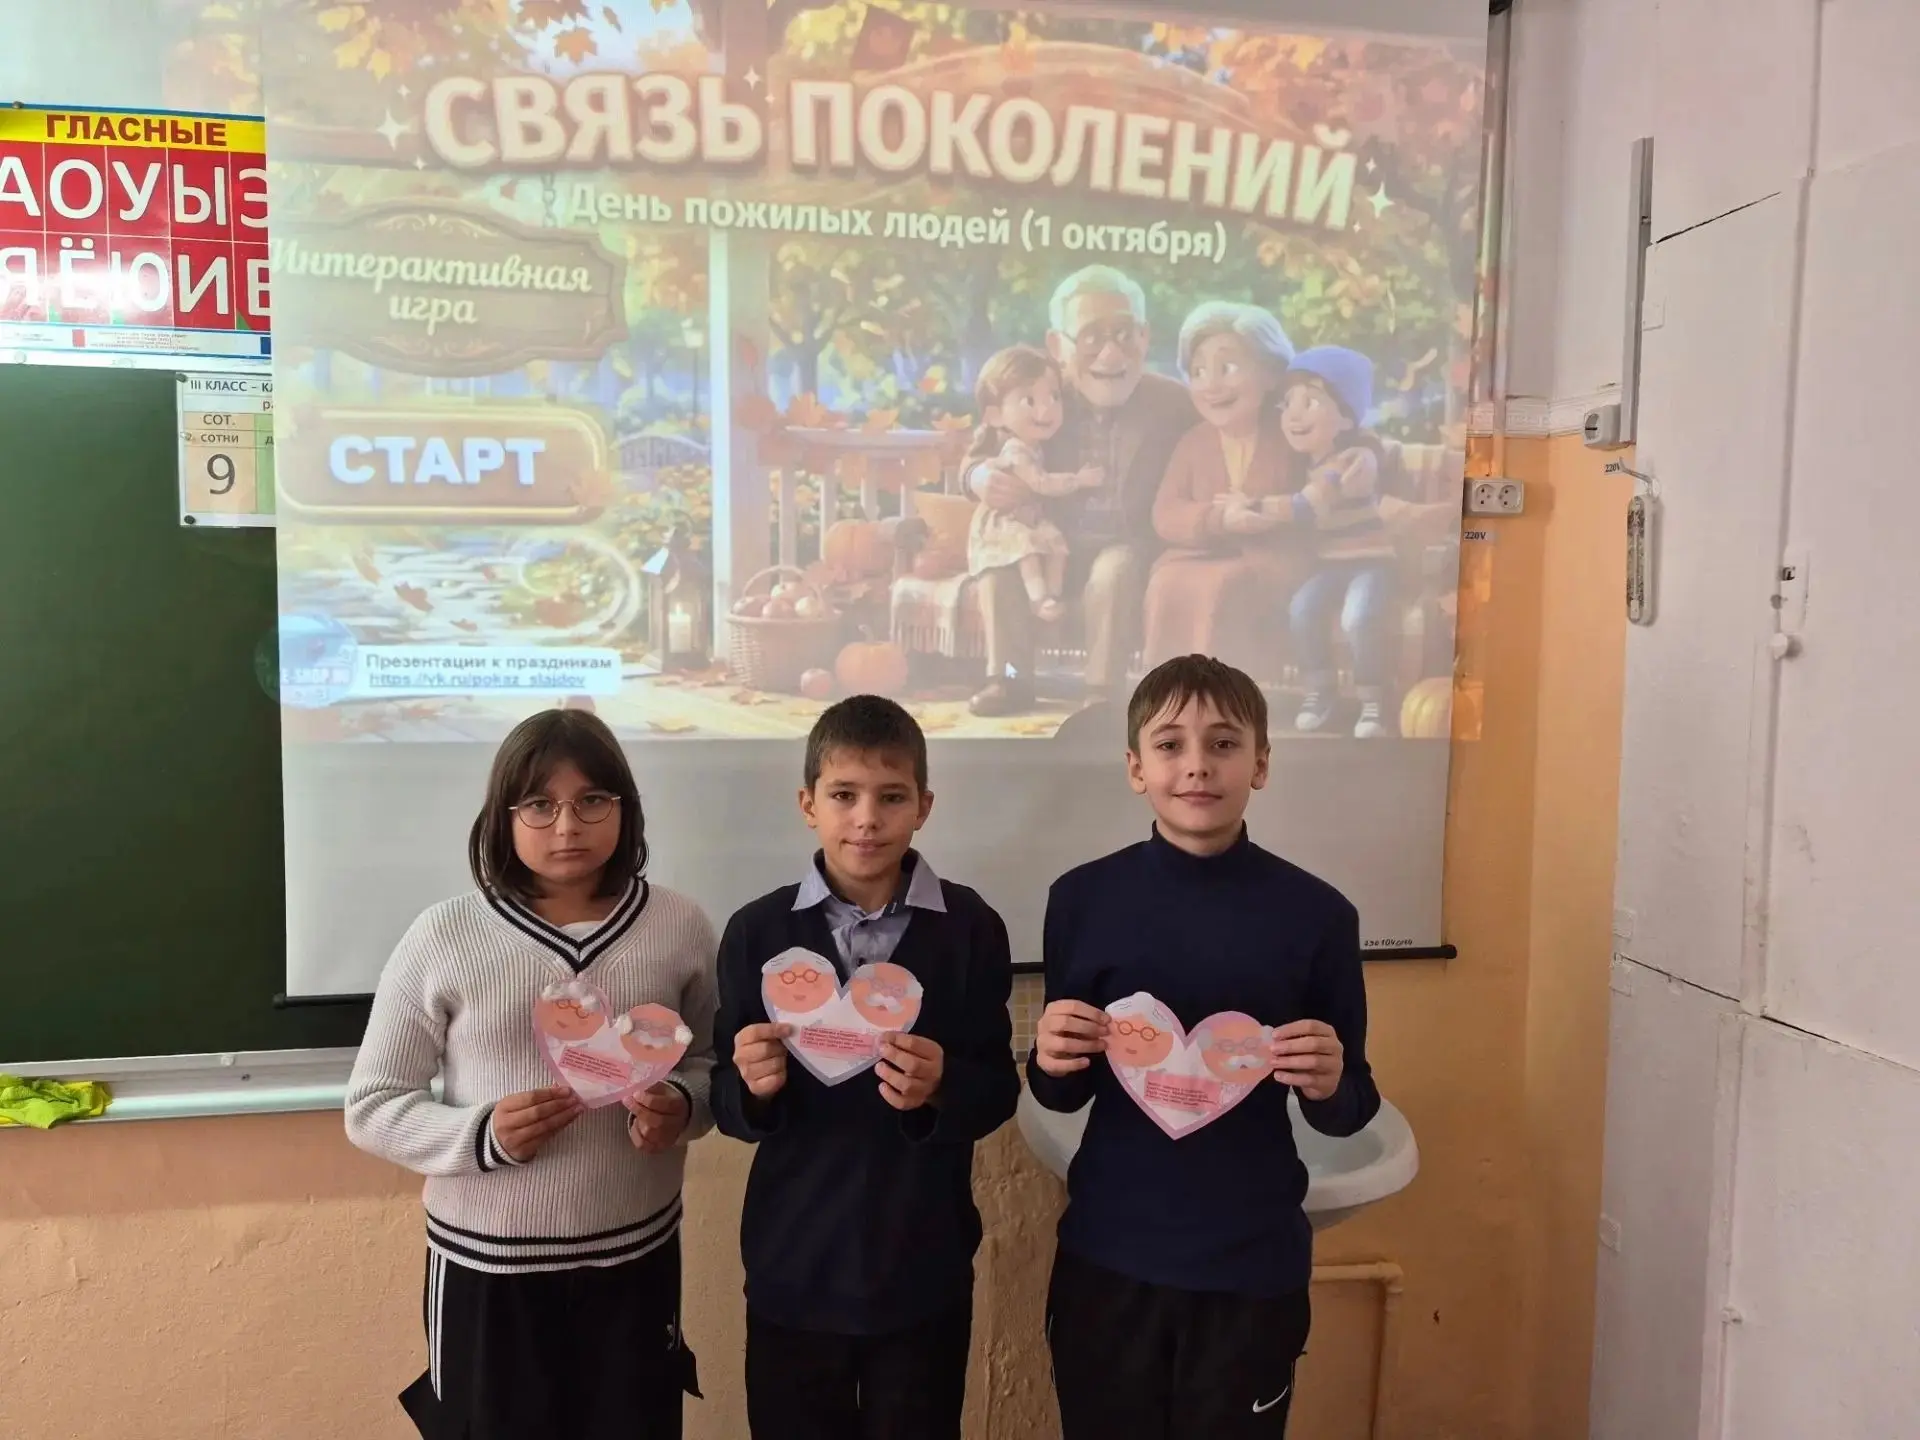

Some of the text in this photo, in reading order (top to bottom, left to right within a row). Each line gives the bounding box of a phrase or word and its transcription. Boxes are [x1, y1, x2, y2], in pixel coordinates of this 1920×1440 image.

[46, 114, 227, 146] ГЛАСНЫЕ
[425, 73, 1358, 231] СВЯЗЬ ПОКОЛЕНИЙ
[572, 182, 1228, 264] День пожилых людей (1 октября)
[270, 238, 592, 293] Интерактивная
[389, 294, 478, 336] игра
[206, 381, 247, 392] КЛАСС
[200, 433, 239, 443] сотни
[203, 414, 236, 426] СОТ.
[207, 454, 236, 495] 9
[329, 434, 546, 485] СТАРТ
[1464, 531, 1486, 541] 220V
[366, 653, 612, 672] Презентации к праздникам
